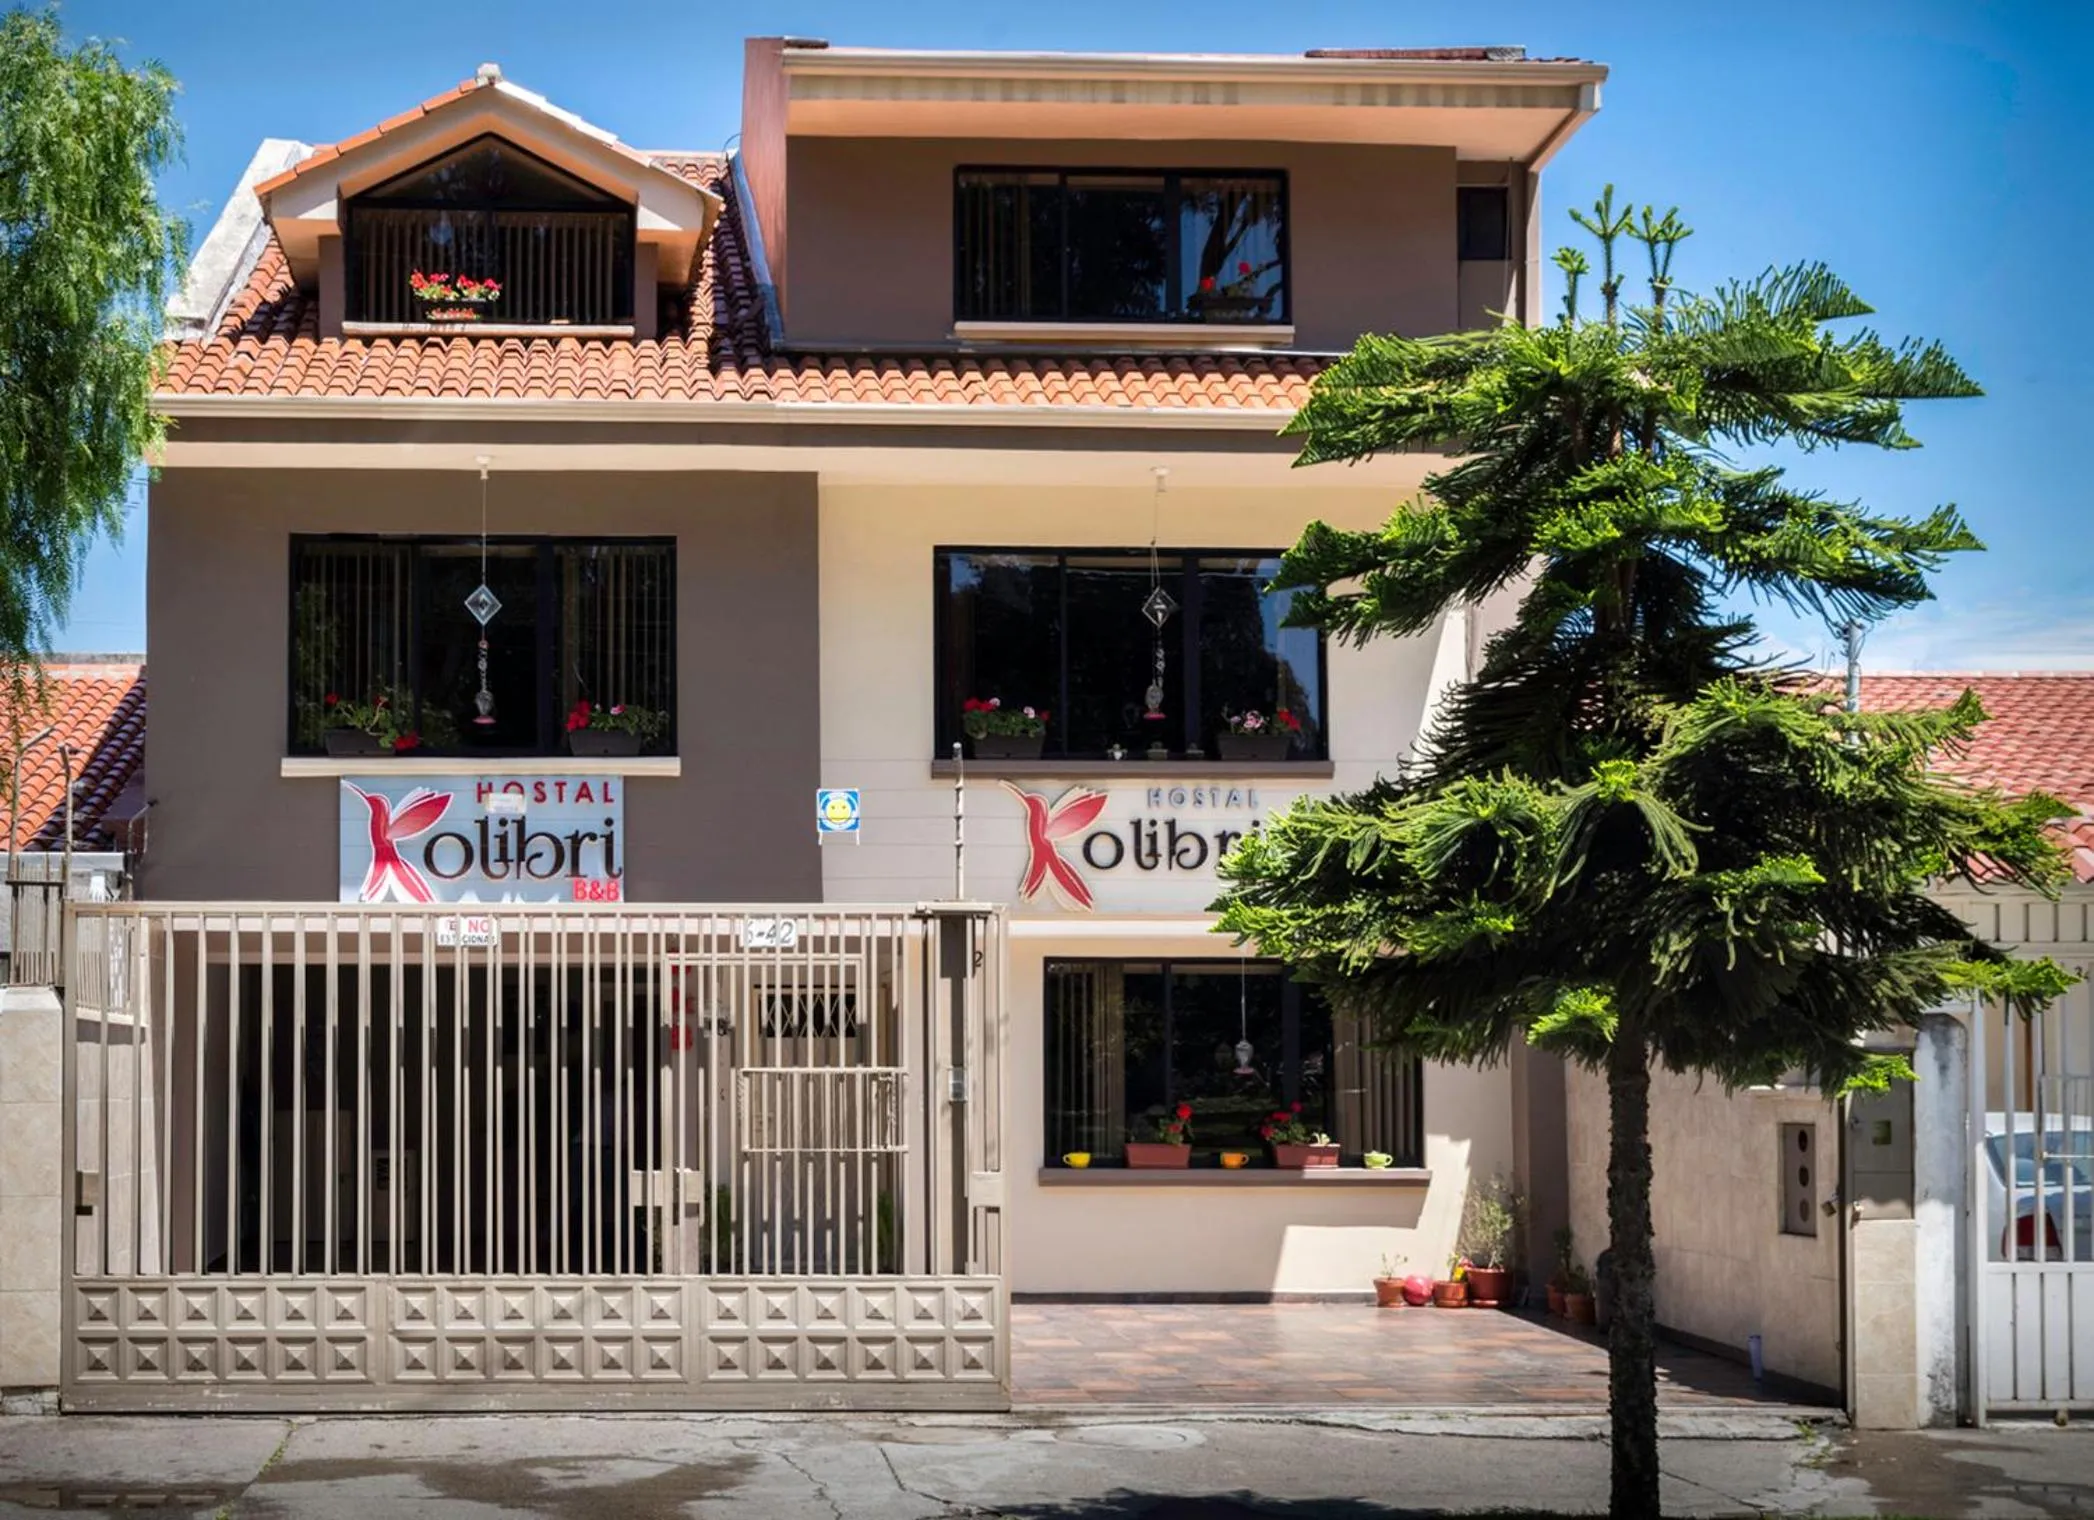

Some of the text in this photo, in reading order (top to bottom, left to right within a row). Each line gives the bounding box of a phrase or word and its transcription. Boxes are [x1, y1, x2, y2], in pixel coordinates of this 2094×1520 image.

[476, 781, 615, 803] HOSTAL
[1147, 787, 1259, 808] HOSTAL
[573, 879, 620, 902] B&B
[468, 920, 490, 933] NO
